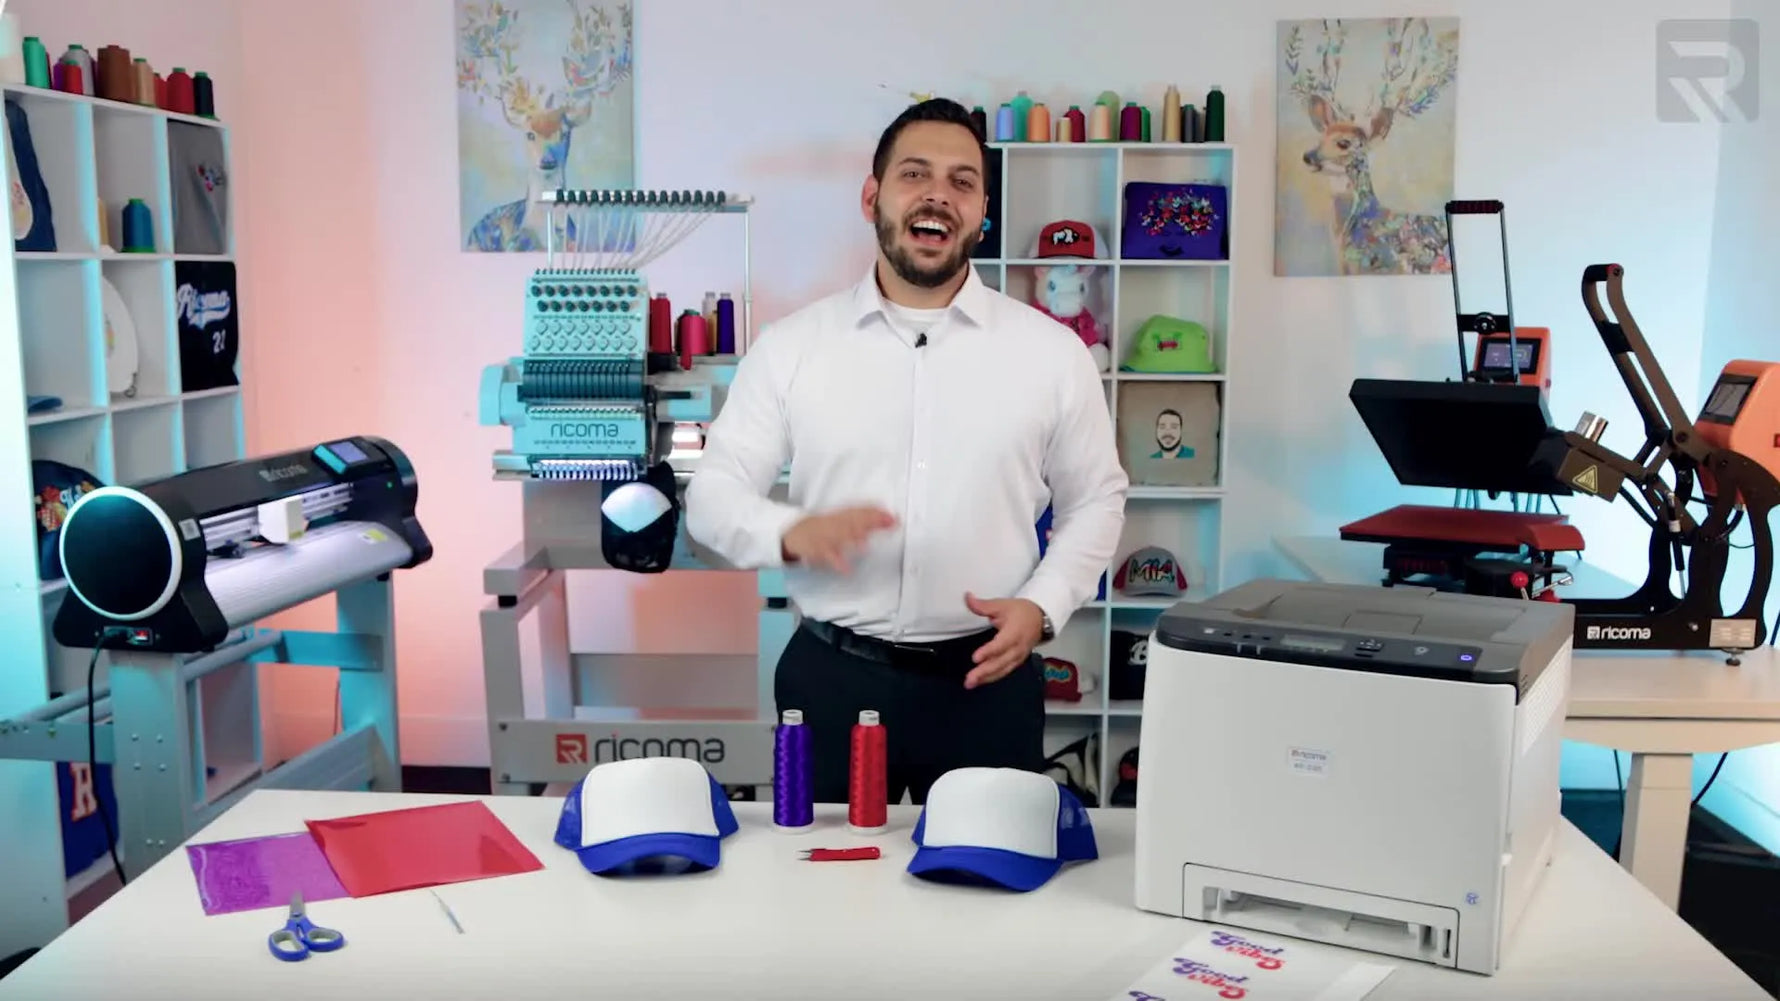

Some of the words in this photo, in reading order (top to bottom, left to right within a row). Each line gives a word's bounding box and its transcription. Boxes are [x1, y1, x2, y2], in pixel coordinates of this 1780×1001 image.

[550, 421, 619, 438] ricoma
[1601, 626, 1651, 640] ricoma
[594, 730, 726, 764] ricoma
[1210, 930, 1285, 955] Good
[1172, 957, 1249, 984] Good
